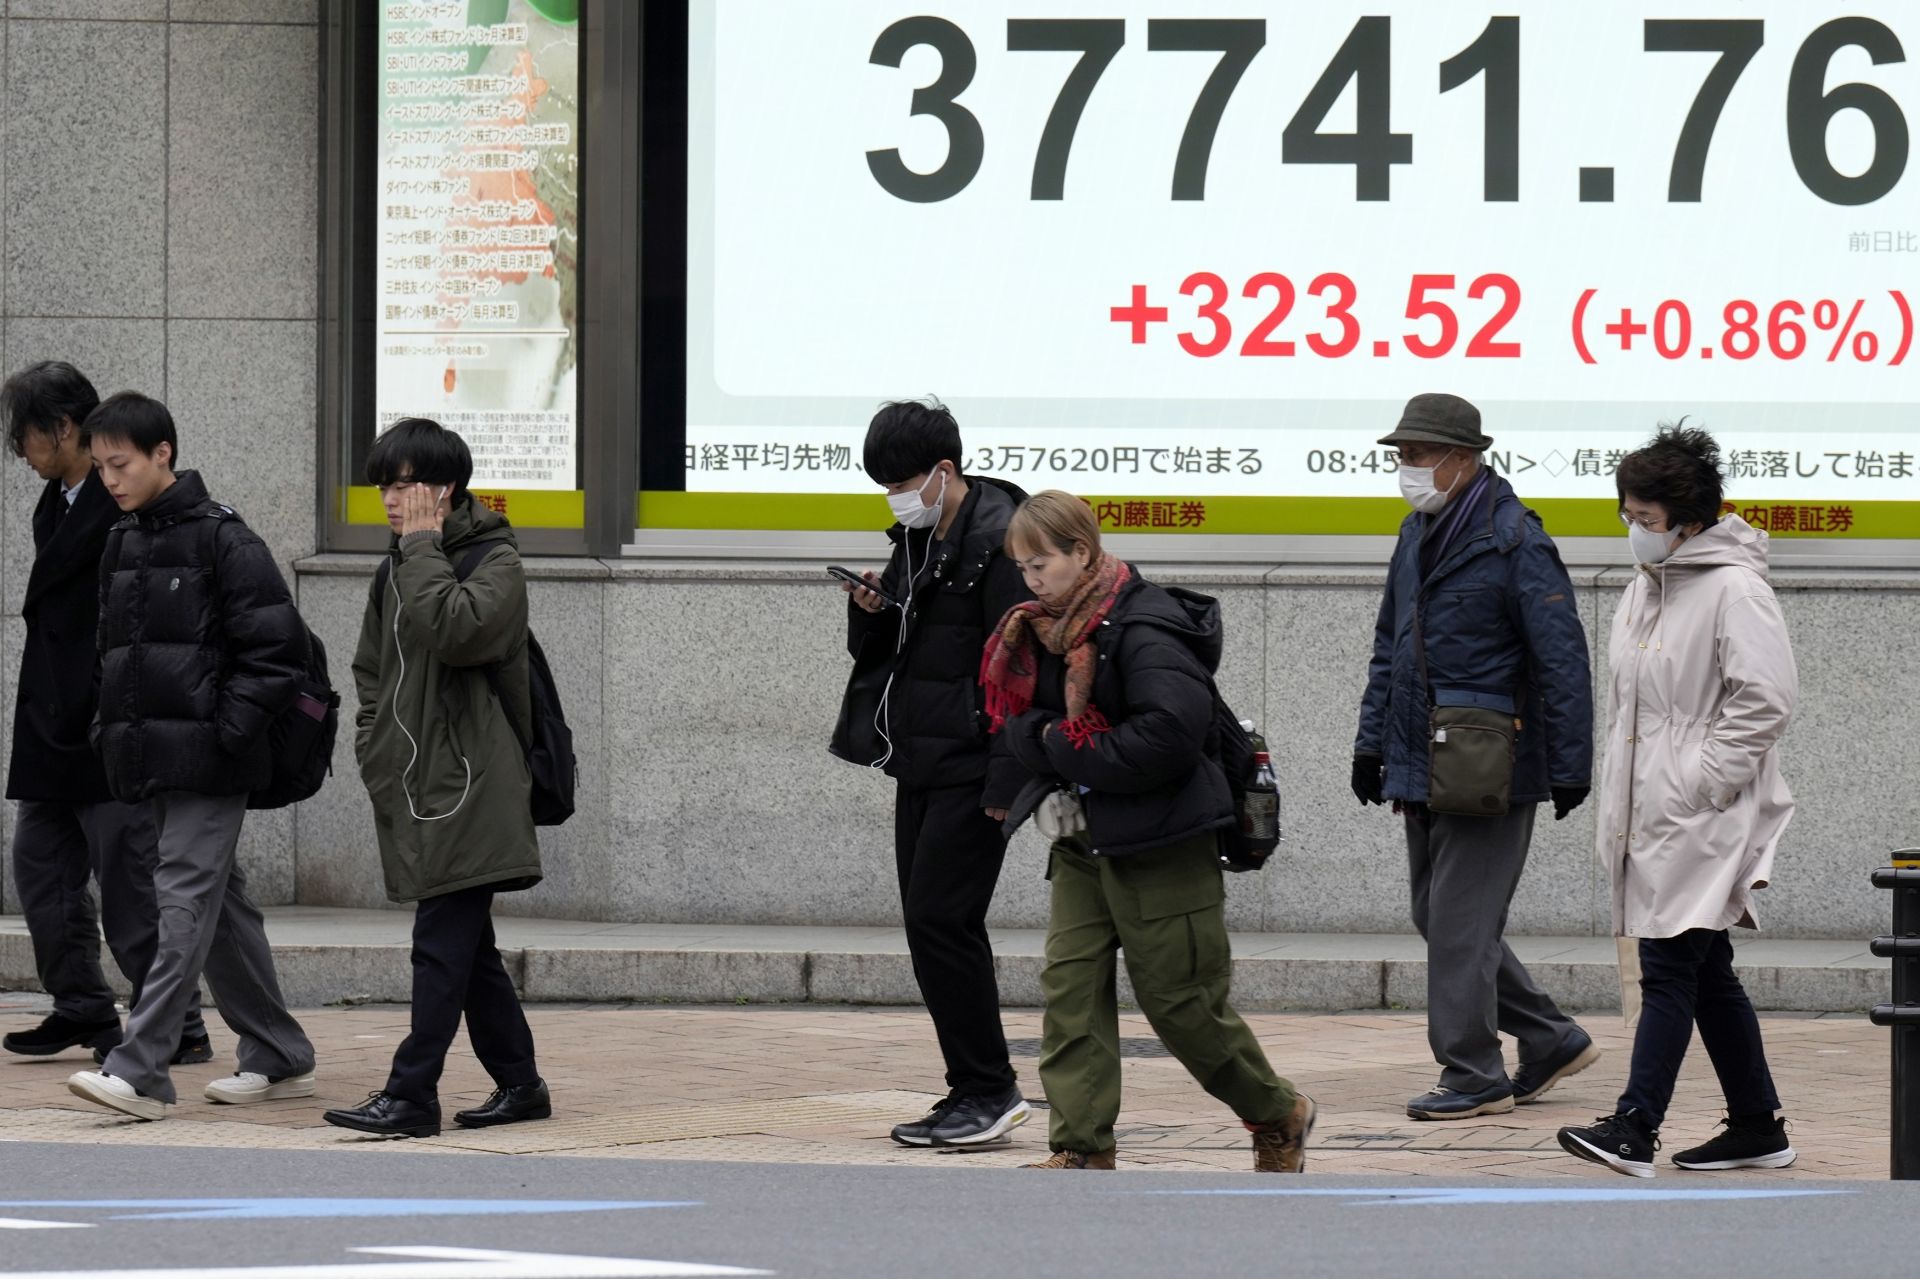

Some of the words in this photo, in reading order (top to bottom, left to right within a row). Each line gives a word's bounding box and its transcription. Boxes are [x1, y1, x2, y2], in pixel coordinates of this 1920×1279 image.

[866, 15, 1910, 206] 37741.76
[1848, 230, 1918, 252] 前日比
[1110, 272, 1522, 359] +323.52
[1571, 288, 1914, 366] (+0.86%)
[1098, 501, 1205, 527] 内藤証券
[1743, 505, 1853, 532] 内藤証券
